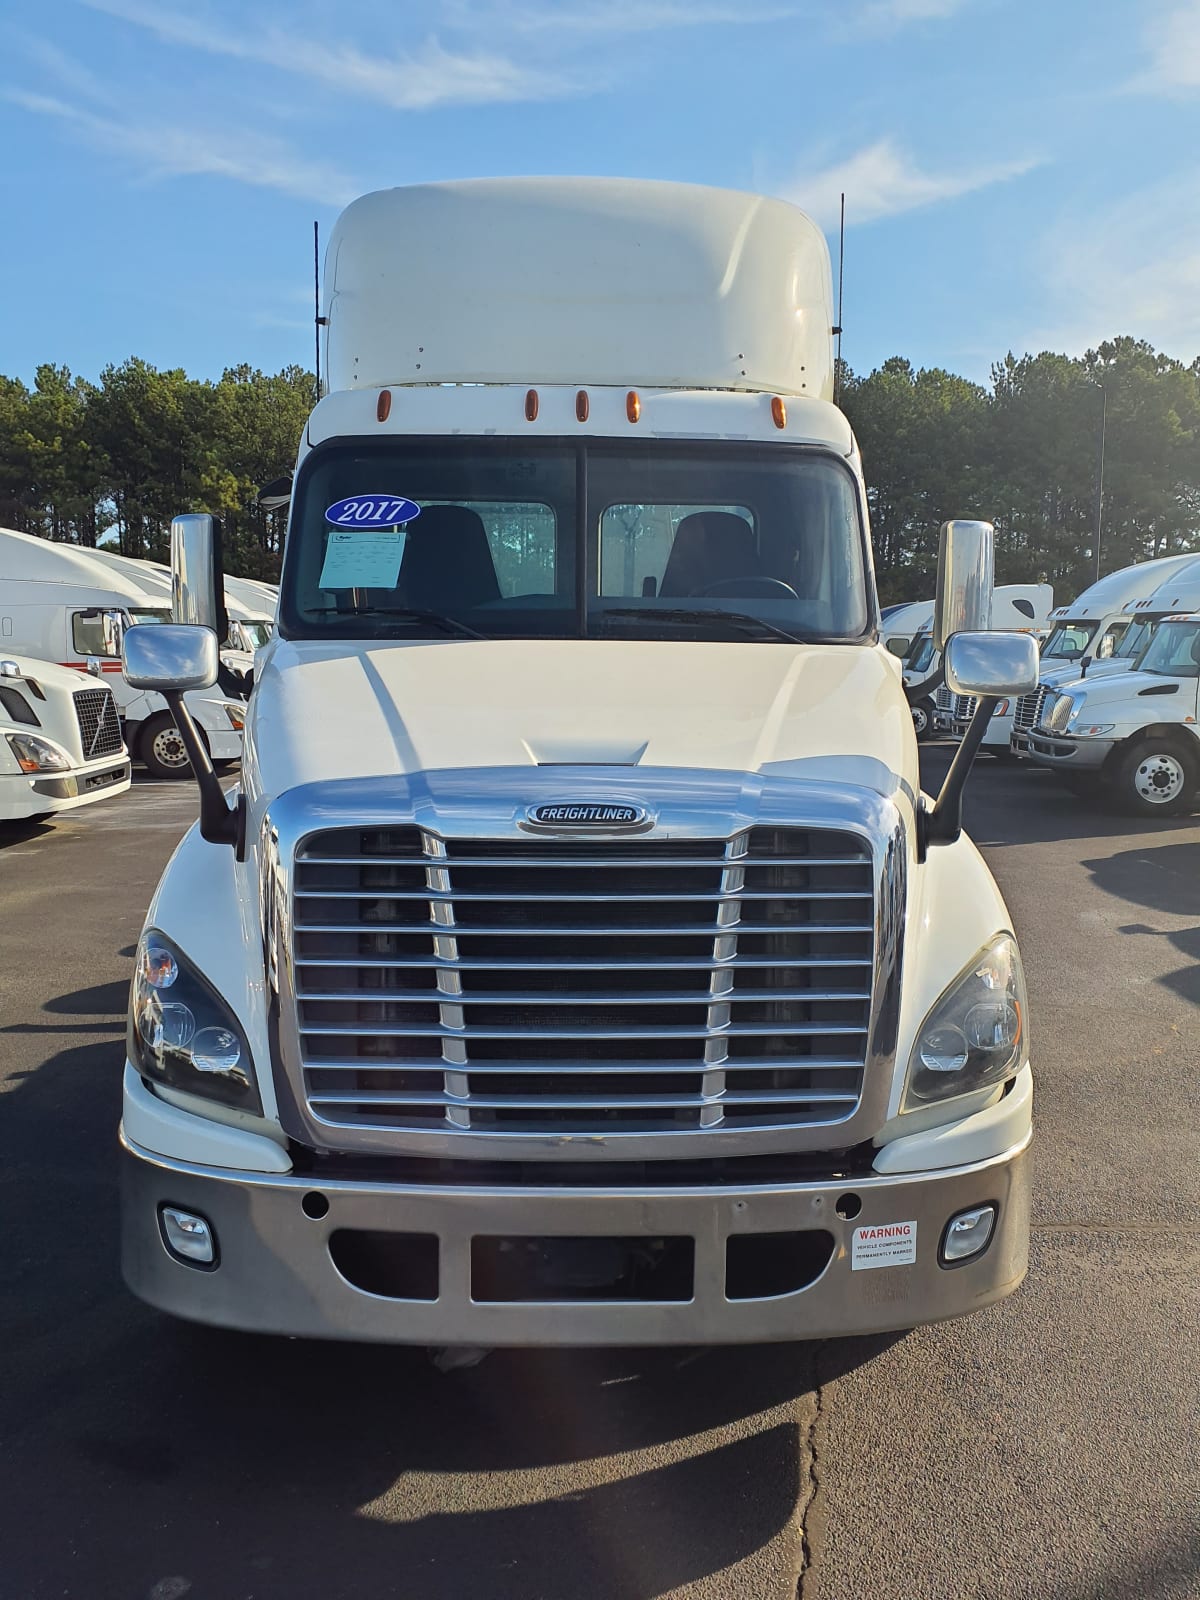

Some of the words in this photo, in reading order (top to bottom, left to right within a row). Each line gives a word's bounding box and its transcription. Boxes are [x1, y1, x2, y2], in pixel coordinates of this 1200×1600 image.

[337, 501, 406, 521] 2017
[541, 807, 633, 820] FREIGHTLINER
[860, 1225, 911, 1240] WARNING
[879, 1239, 912, 1248] COMPONENTS
[856, 1251, 892, 1259] PERMANENTLY
